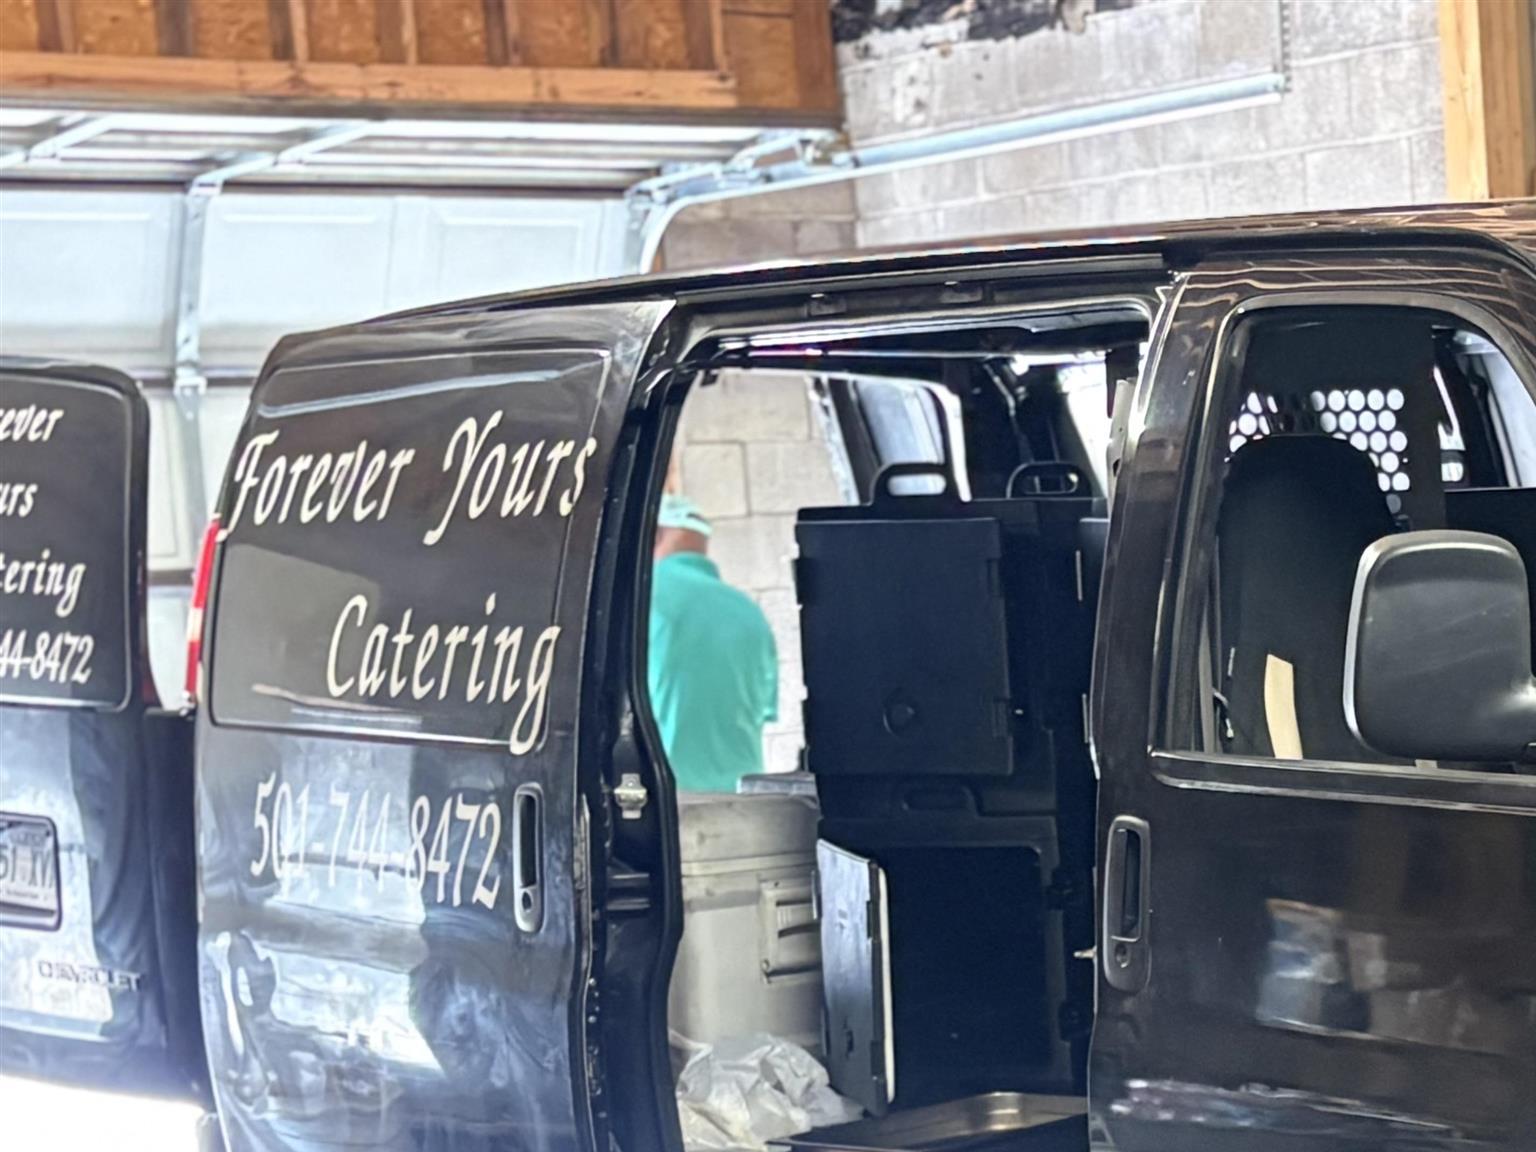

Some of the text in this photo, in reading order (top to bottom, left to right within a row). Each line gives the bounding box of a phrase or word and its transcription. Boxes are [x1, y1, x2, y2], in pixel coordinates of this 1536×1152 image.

[0, 404, 64, 442] ever
[216, 410, 598, 545] Forever Yours
[327, 593, 561, 755] Catering
[251, 772, 500, 910] 501-744-8472
